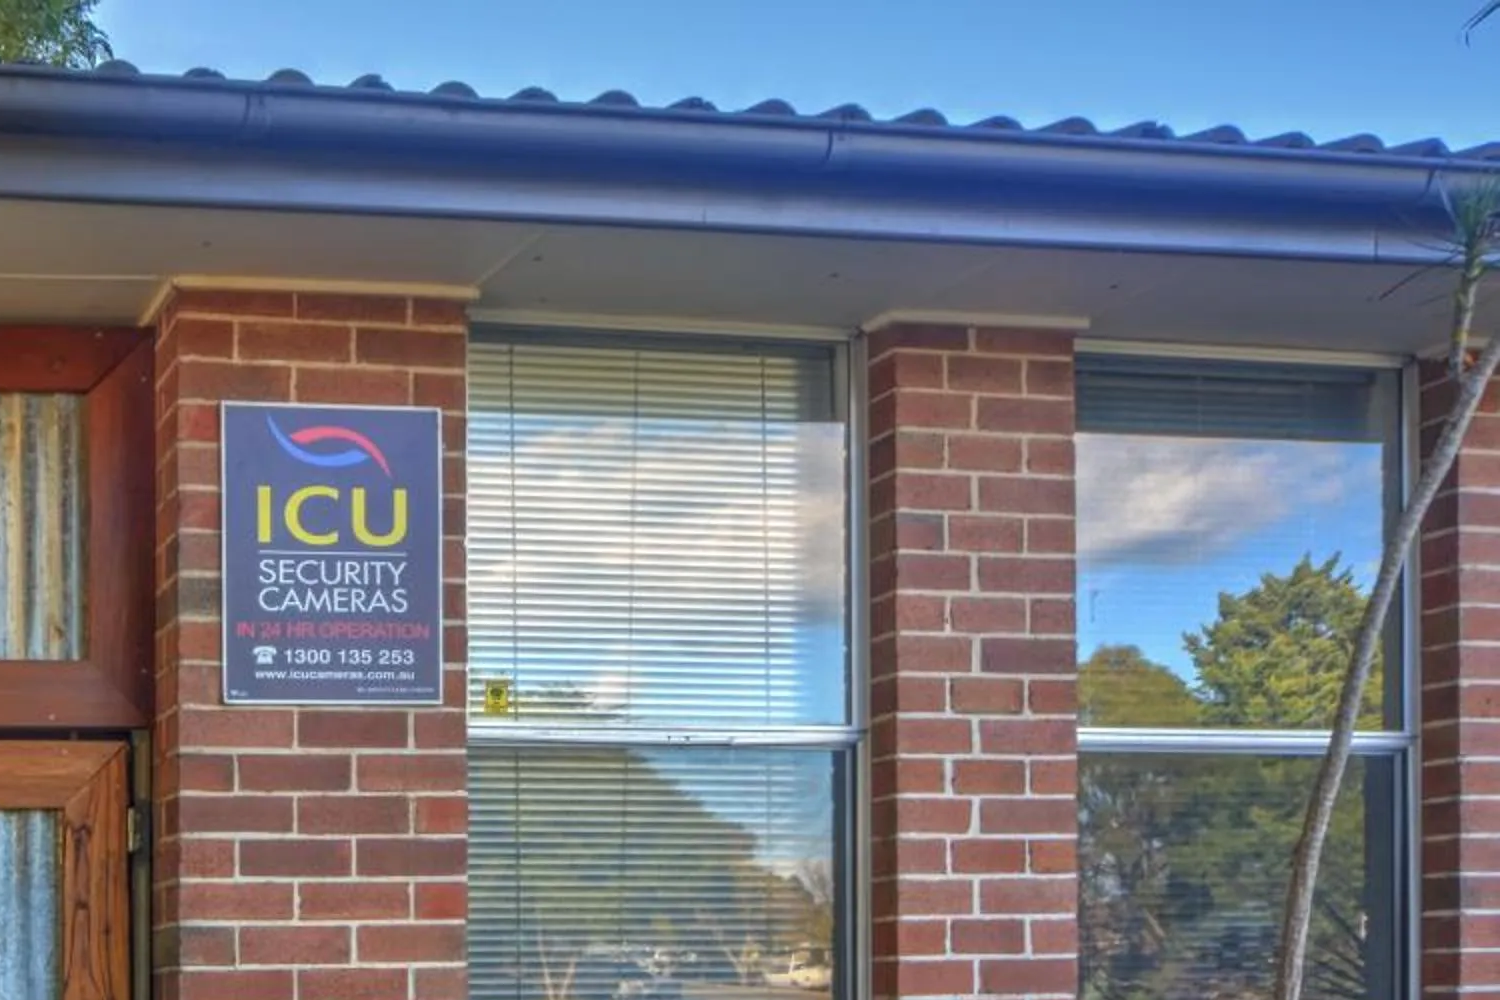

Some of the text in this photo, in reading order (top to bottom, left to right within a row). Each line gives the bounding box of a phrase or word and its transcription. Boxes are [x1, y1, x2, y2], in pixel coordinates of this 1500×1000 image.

[257, 485, 408, 546] ICU
[258, 559, 407, 586] SECURITY
[258, 587, 408, 613] CAMERAS
[236, 621, 255, 639] IN
[287, 622, 314, 639] HR
[319, 622, 430, 640] OPERATION
[285, 648, 415, 665] 1300 135 253
[255, 670, 416, 681] www.icucameras.com.au
